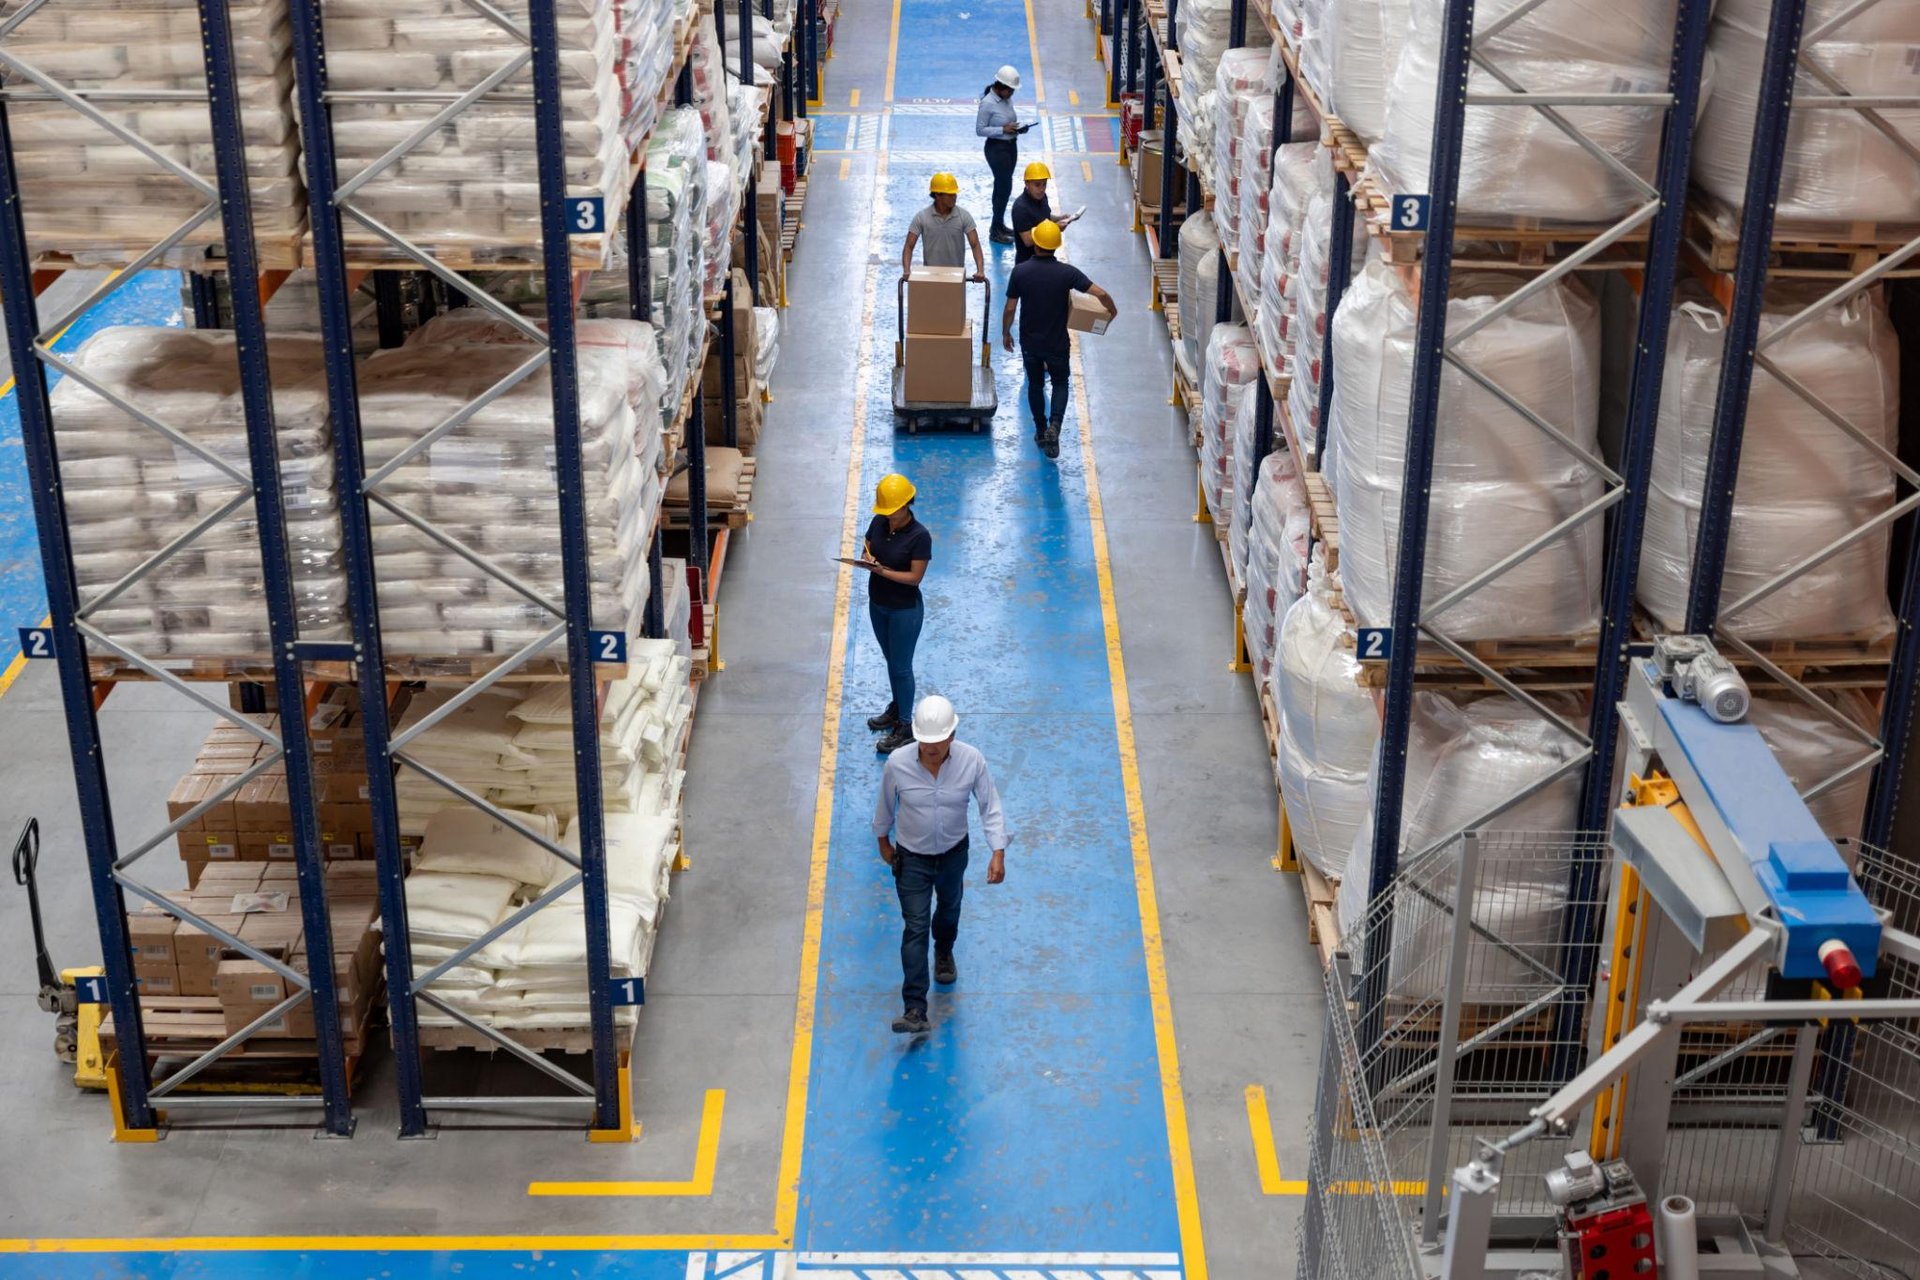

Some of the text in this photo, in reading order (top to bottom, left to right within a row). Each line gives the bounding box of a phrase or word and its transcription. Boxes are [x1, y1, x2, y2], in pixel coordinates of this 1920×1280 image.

[576, 202, 596, 230] 3
[1401, 198, 1420, 228] 3
[29, 631, 49, 656] 2
[600, 633, 618, 659] 2
[1365, 631, 1383, 657] 2
[85, 979, 100, 1001] 1
[620, 981, 634, 1003] 1
